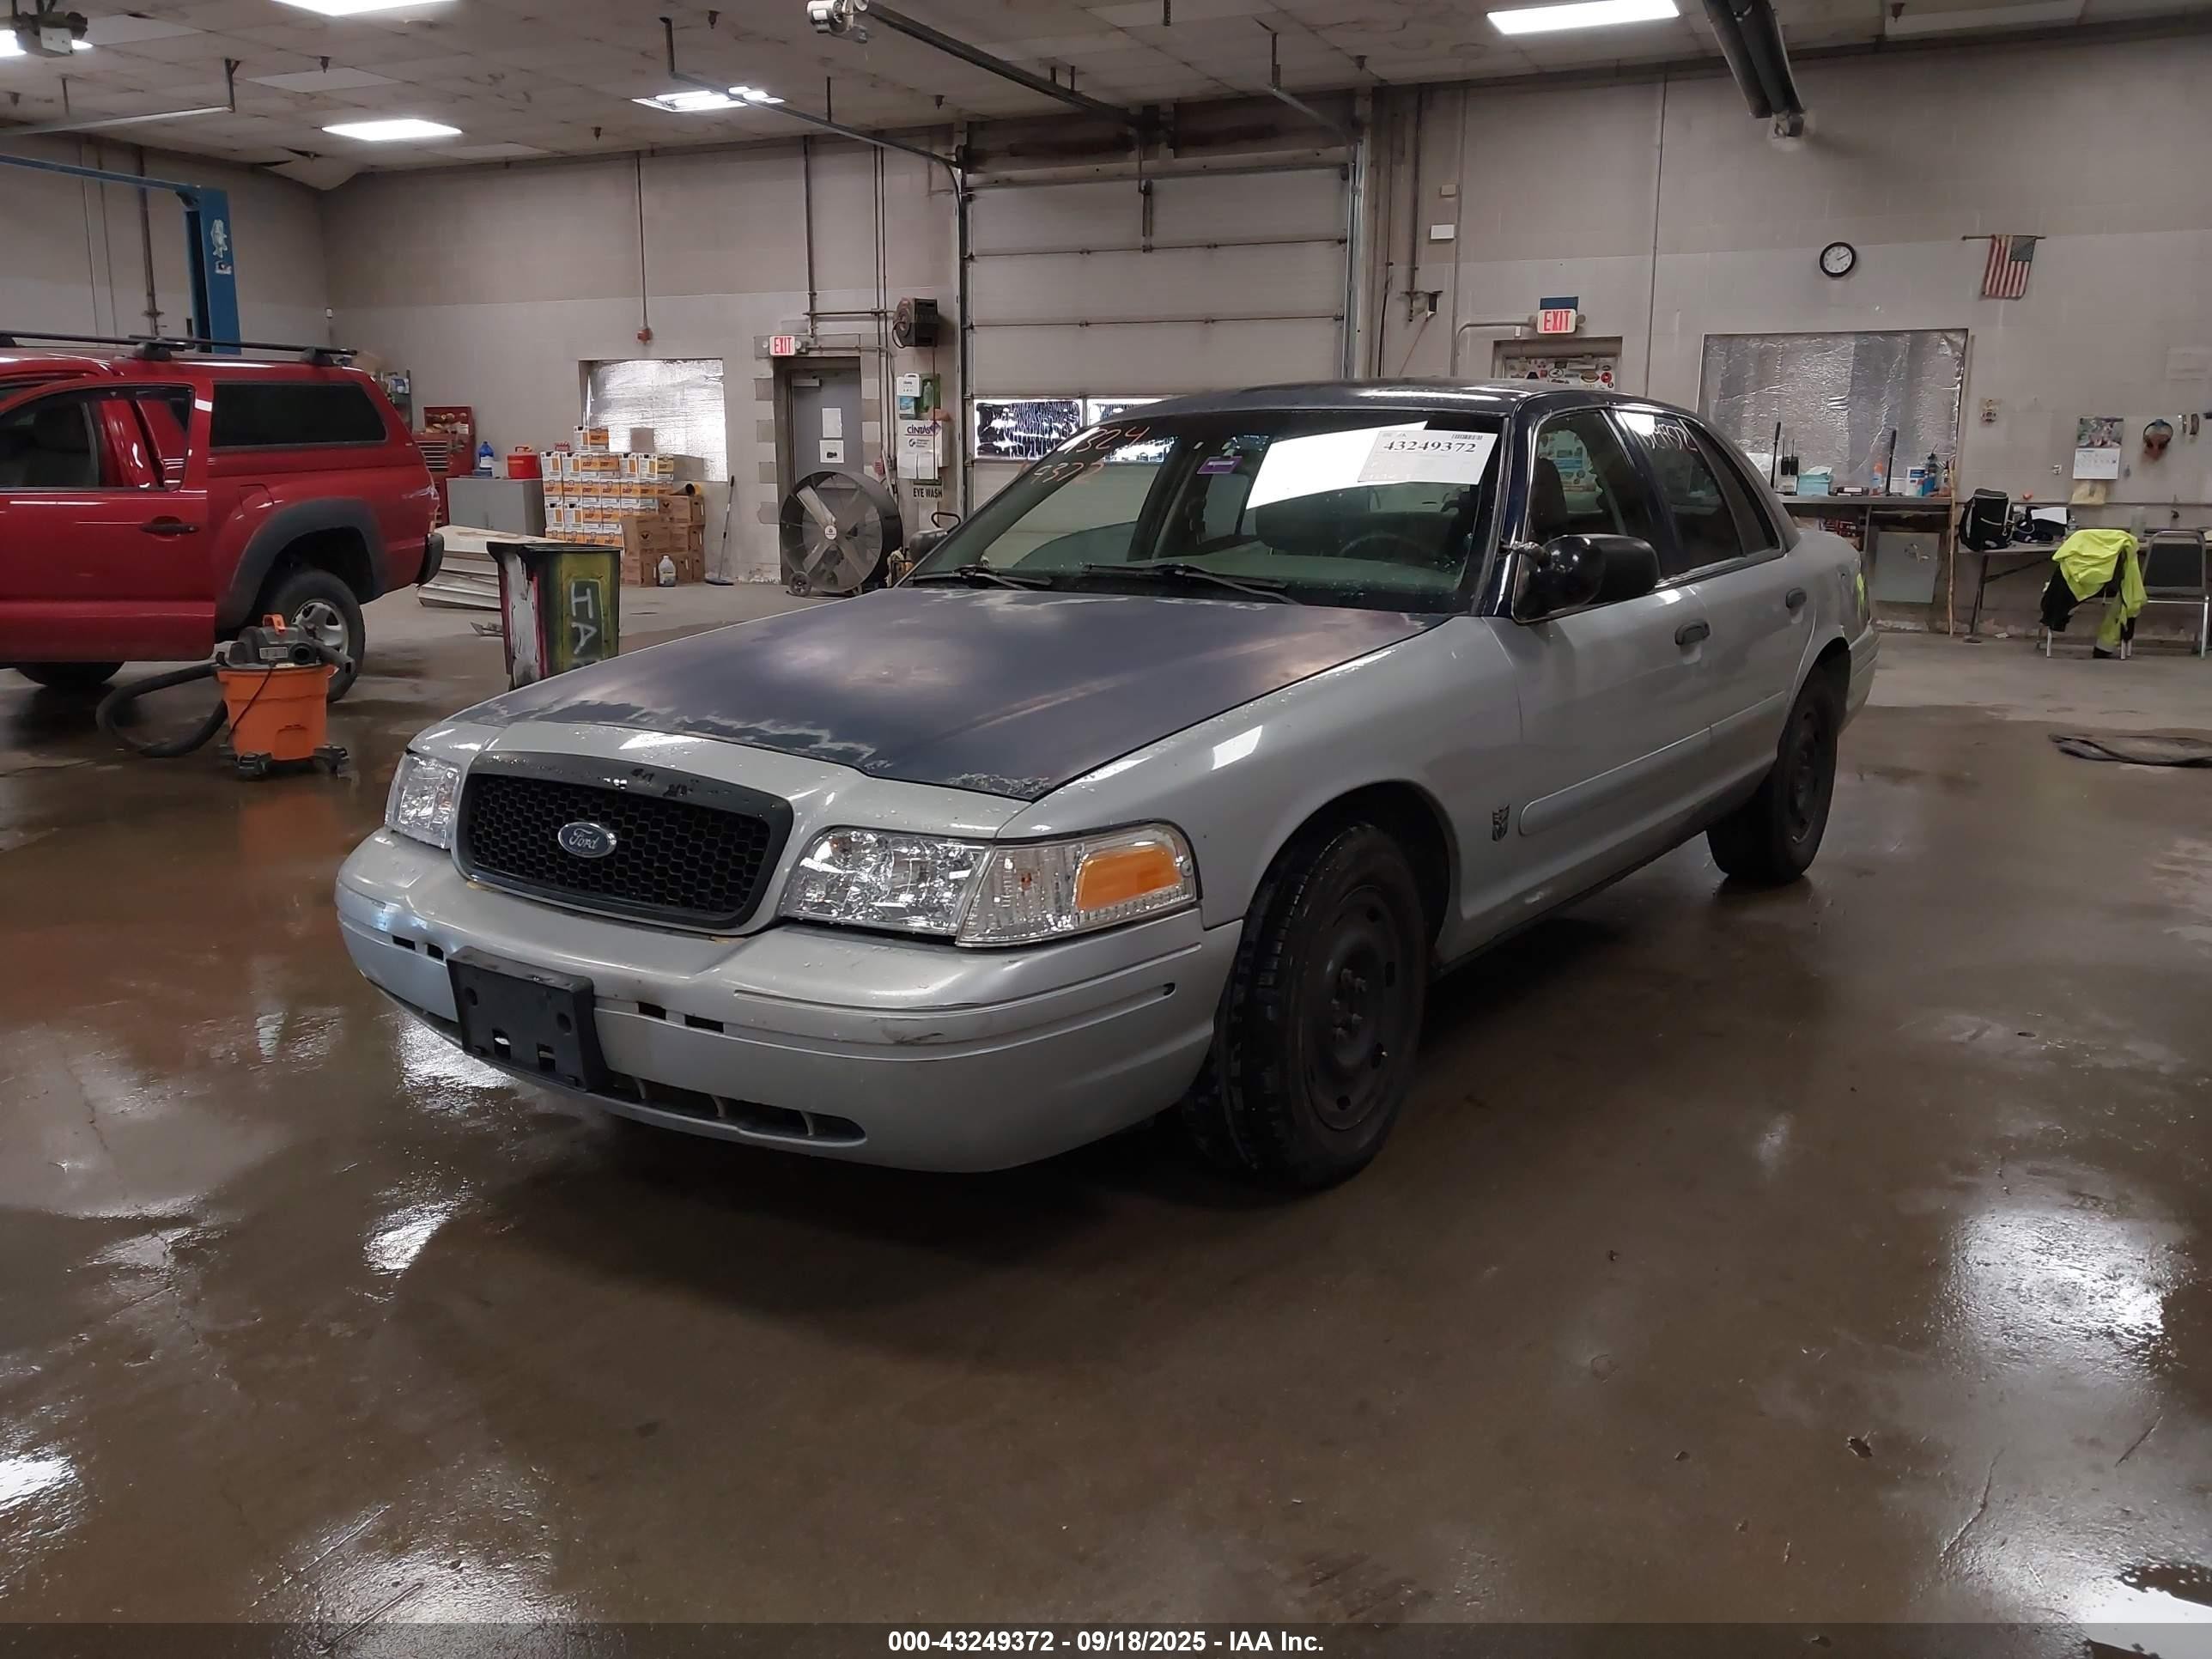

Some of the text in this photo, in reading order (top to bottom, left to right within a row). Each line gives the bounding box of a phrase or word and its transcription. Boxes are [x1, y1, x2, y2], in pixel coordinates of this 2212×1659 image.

[1543, 310, 1571, 331] EXIT
[774, 337, 792, 354] EXIT
[1383, 440, 1477, 453] 43249372
[913, 488, 943, 498] EYE WASH
[568, 828, 600, 849] Ford
